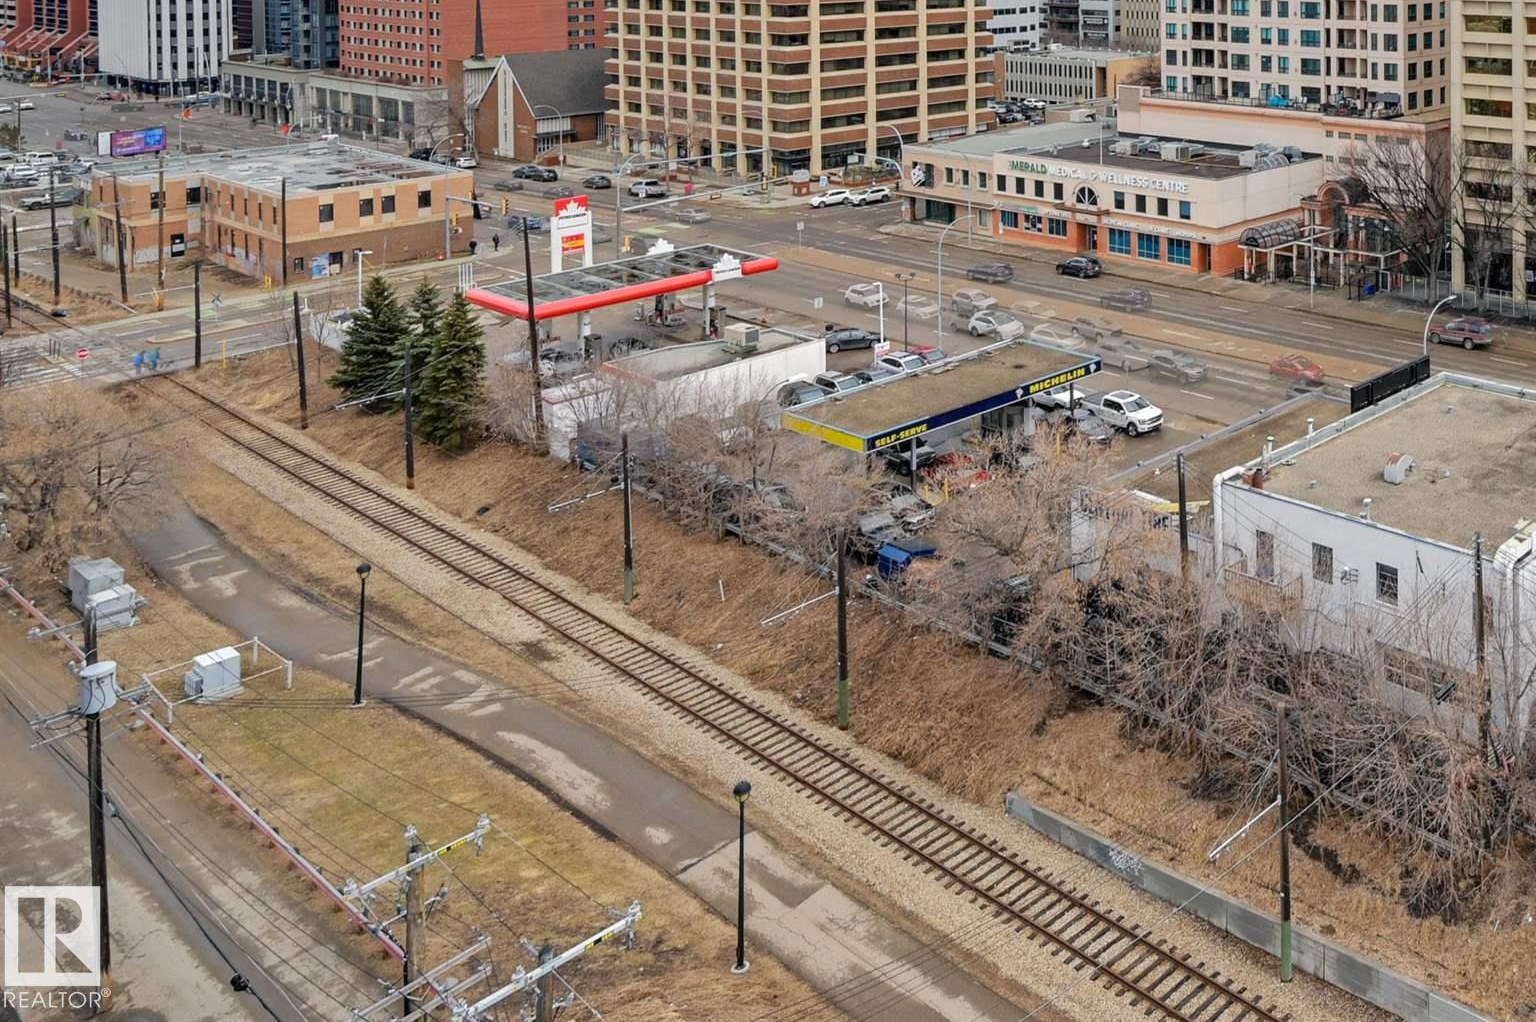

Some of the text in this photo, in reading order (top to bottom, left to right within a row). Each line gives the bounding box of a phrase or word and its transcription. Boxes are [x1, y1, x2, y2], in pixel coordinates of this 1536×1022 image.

[1100, 171, 1149, 189] WELLNESS
[1149, 179, 1189, 194] CENTRE
[1029, 367, 1086, 394] MICHELIN
[874, 423, 929, 447] SELF-SERVE
